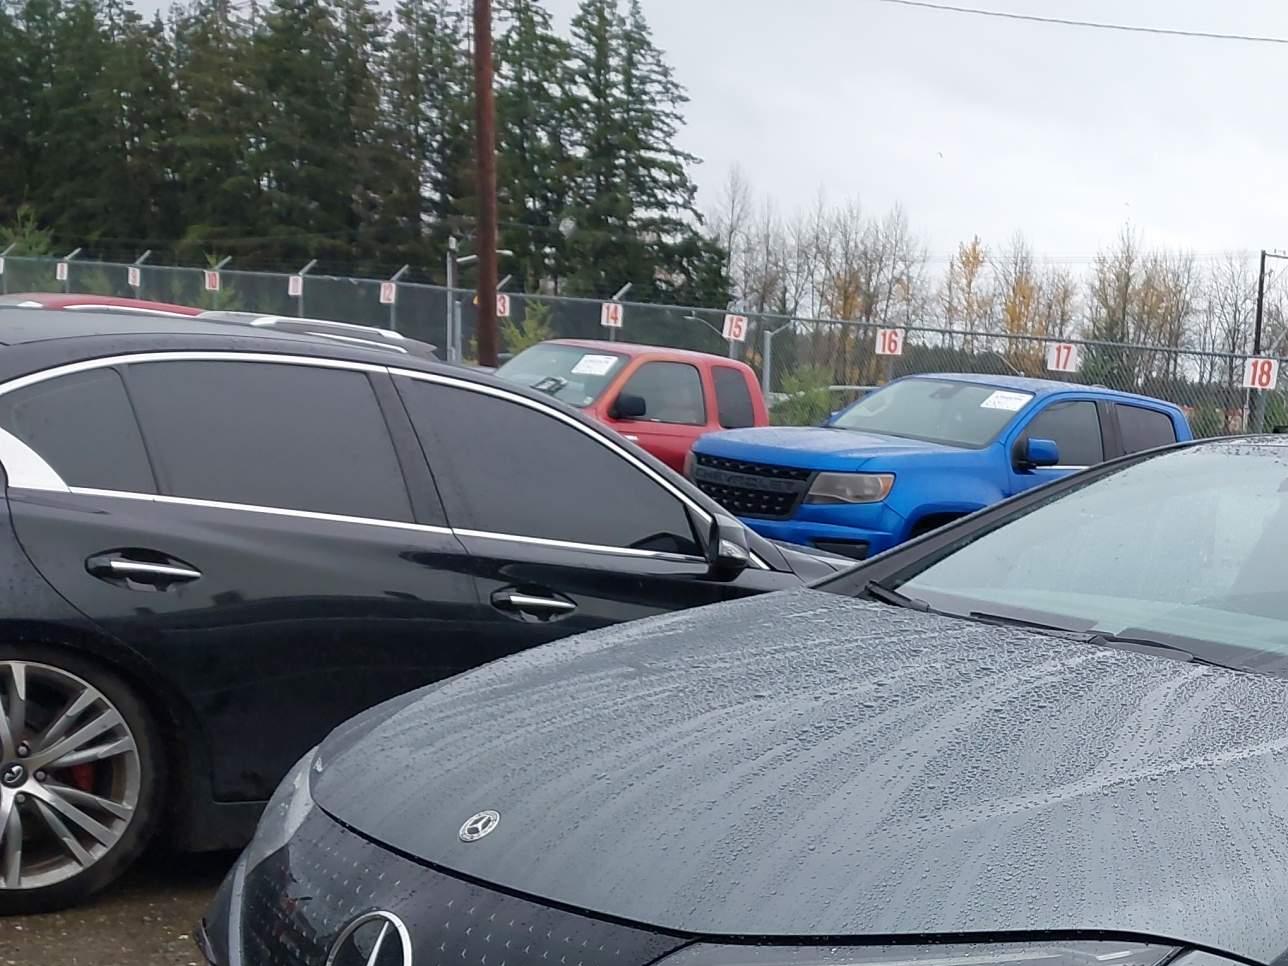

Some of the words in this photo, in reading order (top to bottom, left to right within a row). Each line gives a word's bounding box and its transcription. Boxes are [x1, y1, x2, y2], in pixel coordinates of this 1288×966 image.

[383, 283, 393, 301] 12
[605, 305, 618, 324] 14
[728, 316, 743, 338] 15
[880, 331, 898, 353] 16
[1055, 345, 1072, 370] 17
[1250, 359, 1273, 387] 18
